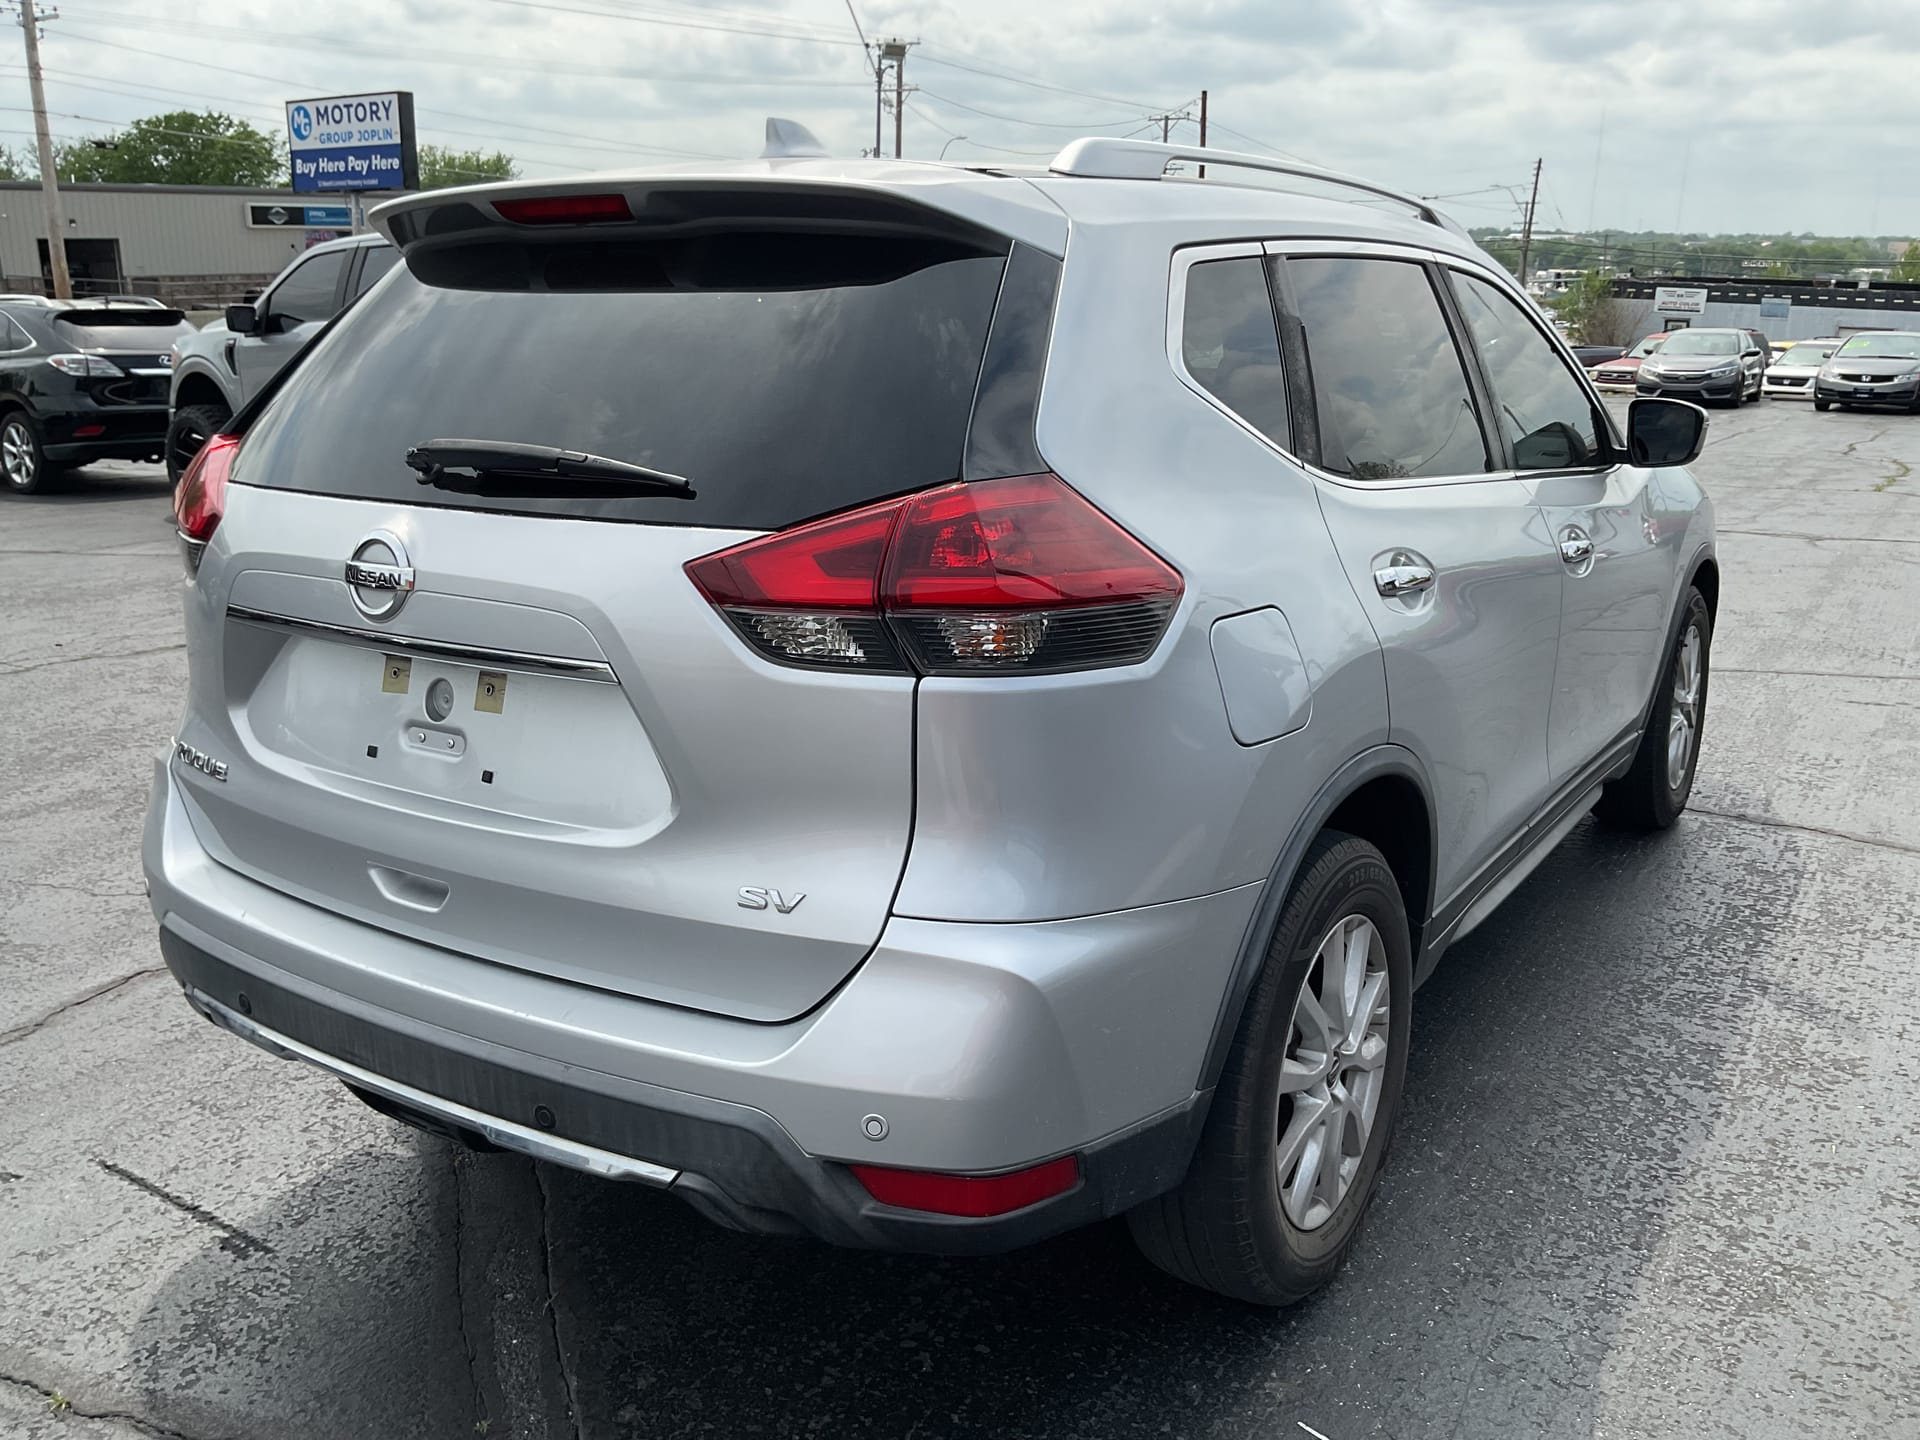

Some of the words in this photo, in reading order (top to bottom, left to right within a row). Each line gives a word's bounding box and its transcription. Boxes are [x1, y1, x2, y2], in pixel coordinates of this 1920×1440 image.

[315, 100, 392, 126] MOTORY
[319, 131, 353, 144] GROUP
[358, 128, 393, 142] JOPLIN
[295, 159, 317, 178] Buy
[318, 157, 346, 173] Here
[348, 156, 369, 176] Pay
[371, 154, 400, 170] Here
[346, 564, 401, 587] NISSAN
[737, 886, 807, 914] SV
